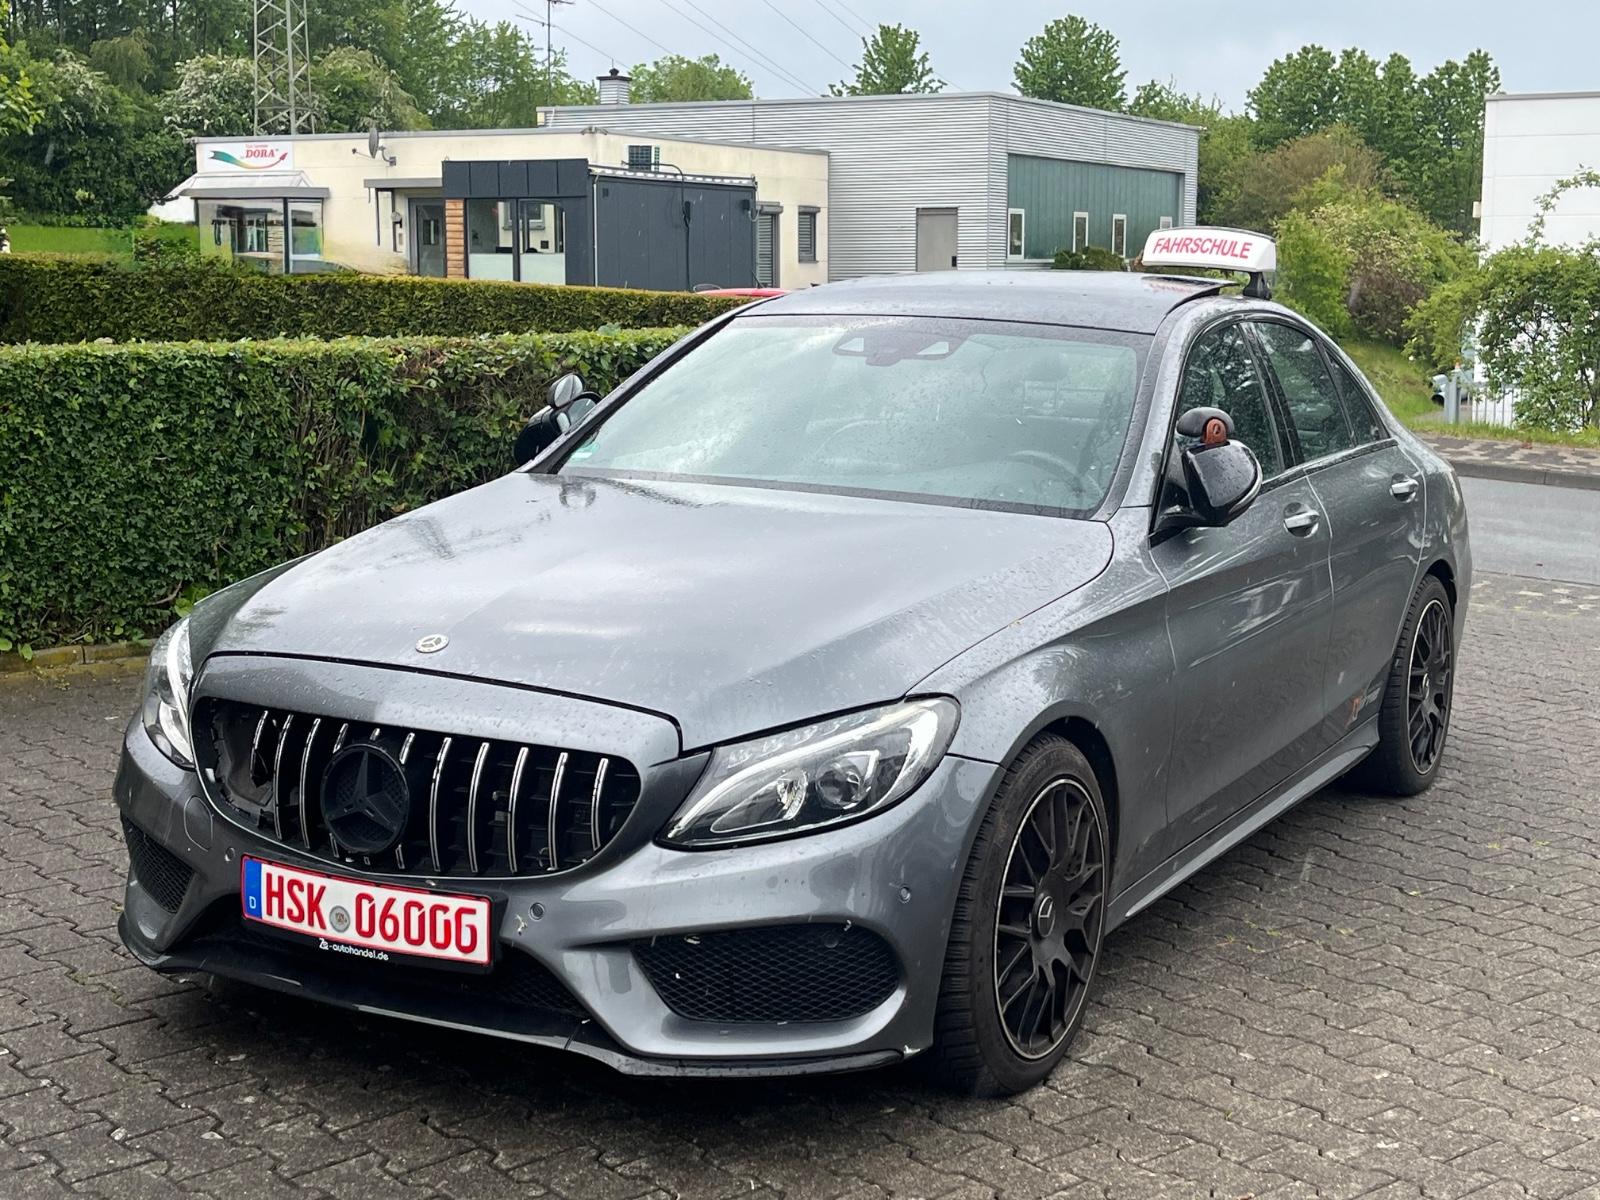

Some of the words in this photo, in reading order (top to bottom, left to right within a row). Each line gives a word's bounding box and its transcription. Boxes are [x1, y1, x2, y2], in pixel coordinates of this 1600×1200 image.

[245, 149, 275, 158] DORA
[1153, 237, 1252, 259] FAHRSCHULE
[249, 895, 257, 909] D
[266, 872, 327, 930] HSK
